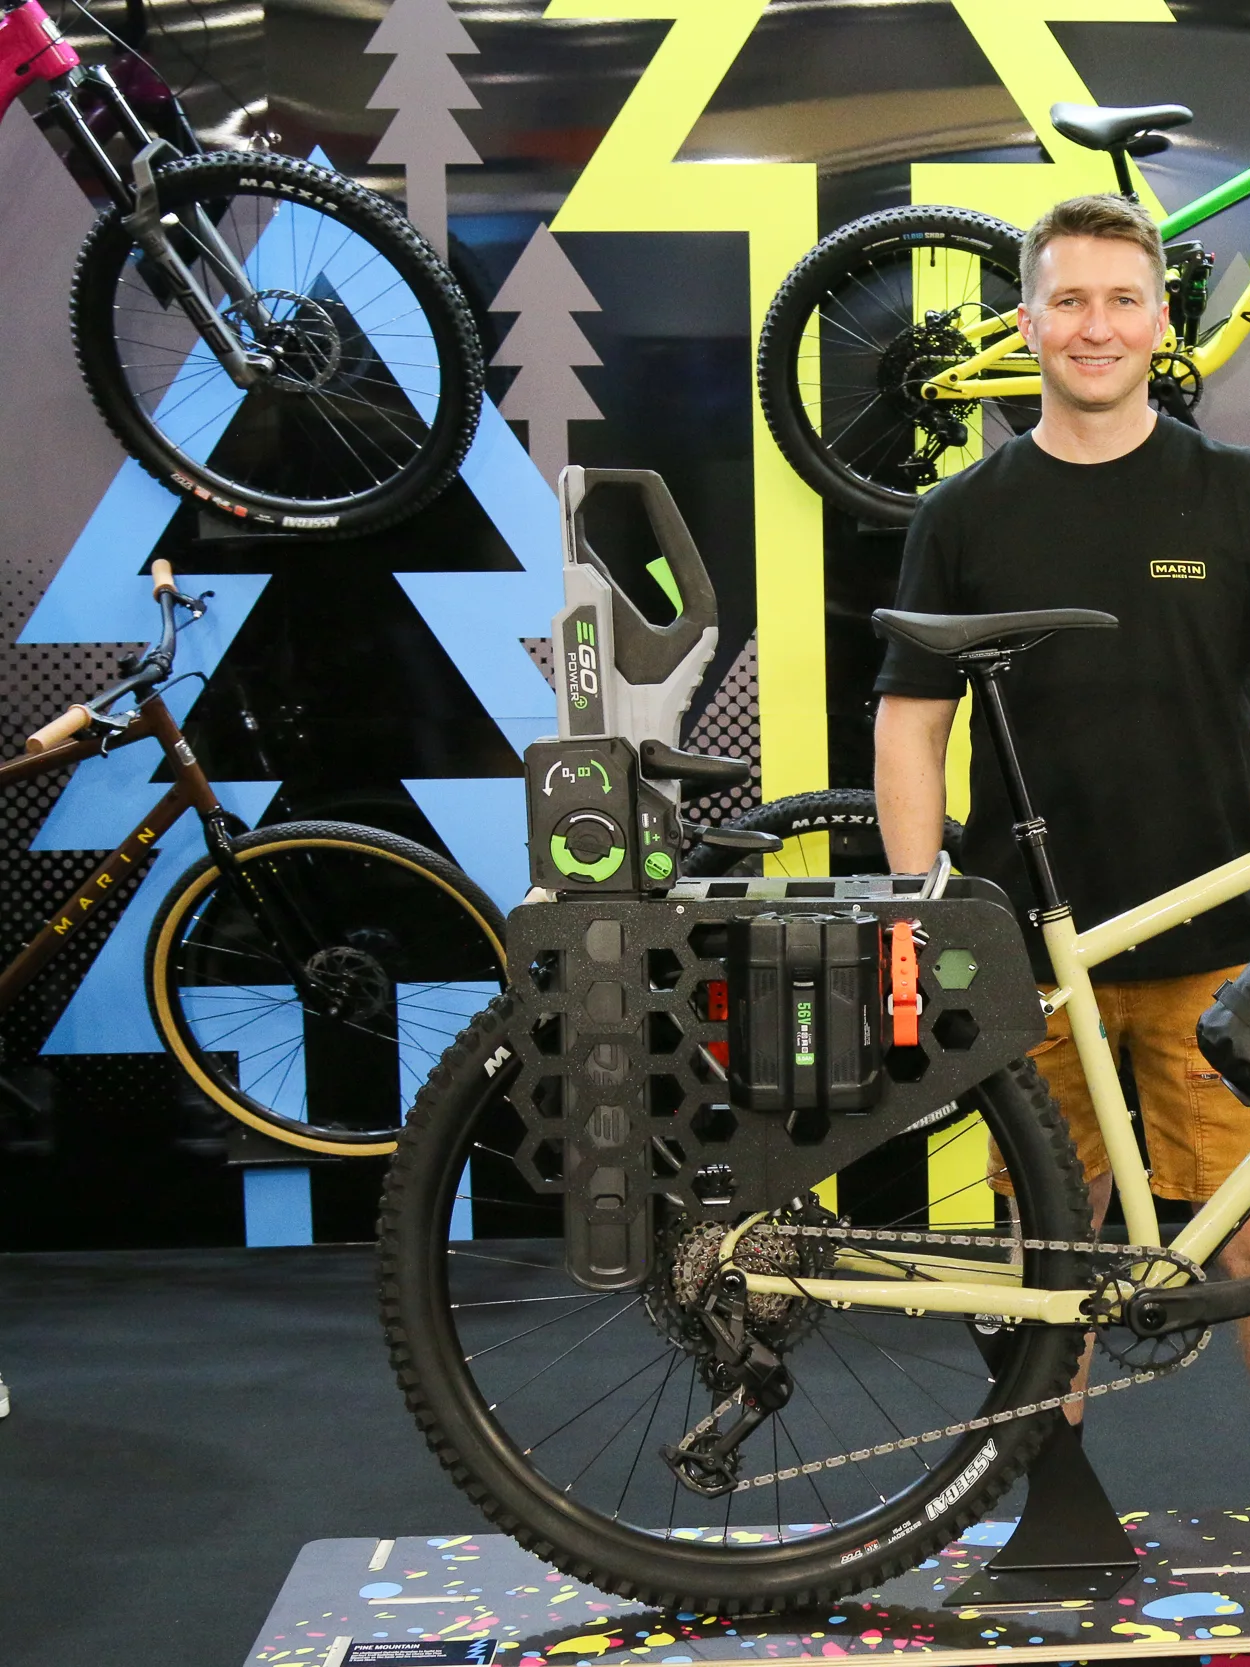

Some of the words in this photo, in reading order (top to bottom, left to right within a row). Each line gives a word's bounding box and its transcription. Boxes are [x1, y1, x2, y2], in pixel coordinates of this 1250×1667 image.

[239, 178, 339, 211] MAXXIS
[1155, 564, 1201, 574] MARIN
[576, 620, 598, 695] EGO
[791, 815, 880, 829] MAXXI
[53, 827, 156, 935] MARIN
[797, 1002, 812, 1025] 56V
[925, 1438, 998, 1521] ASSEGAI
